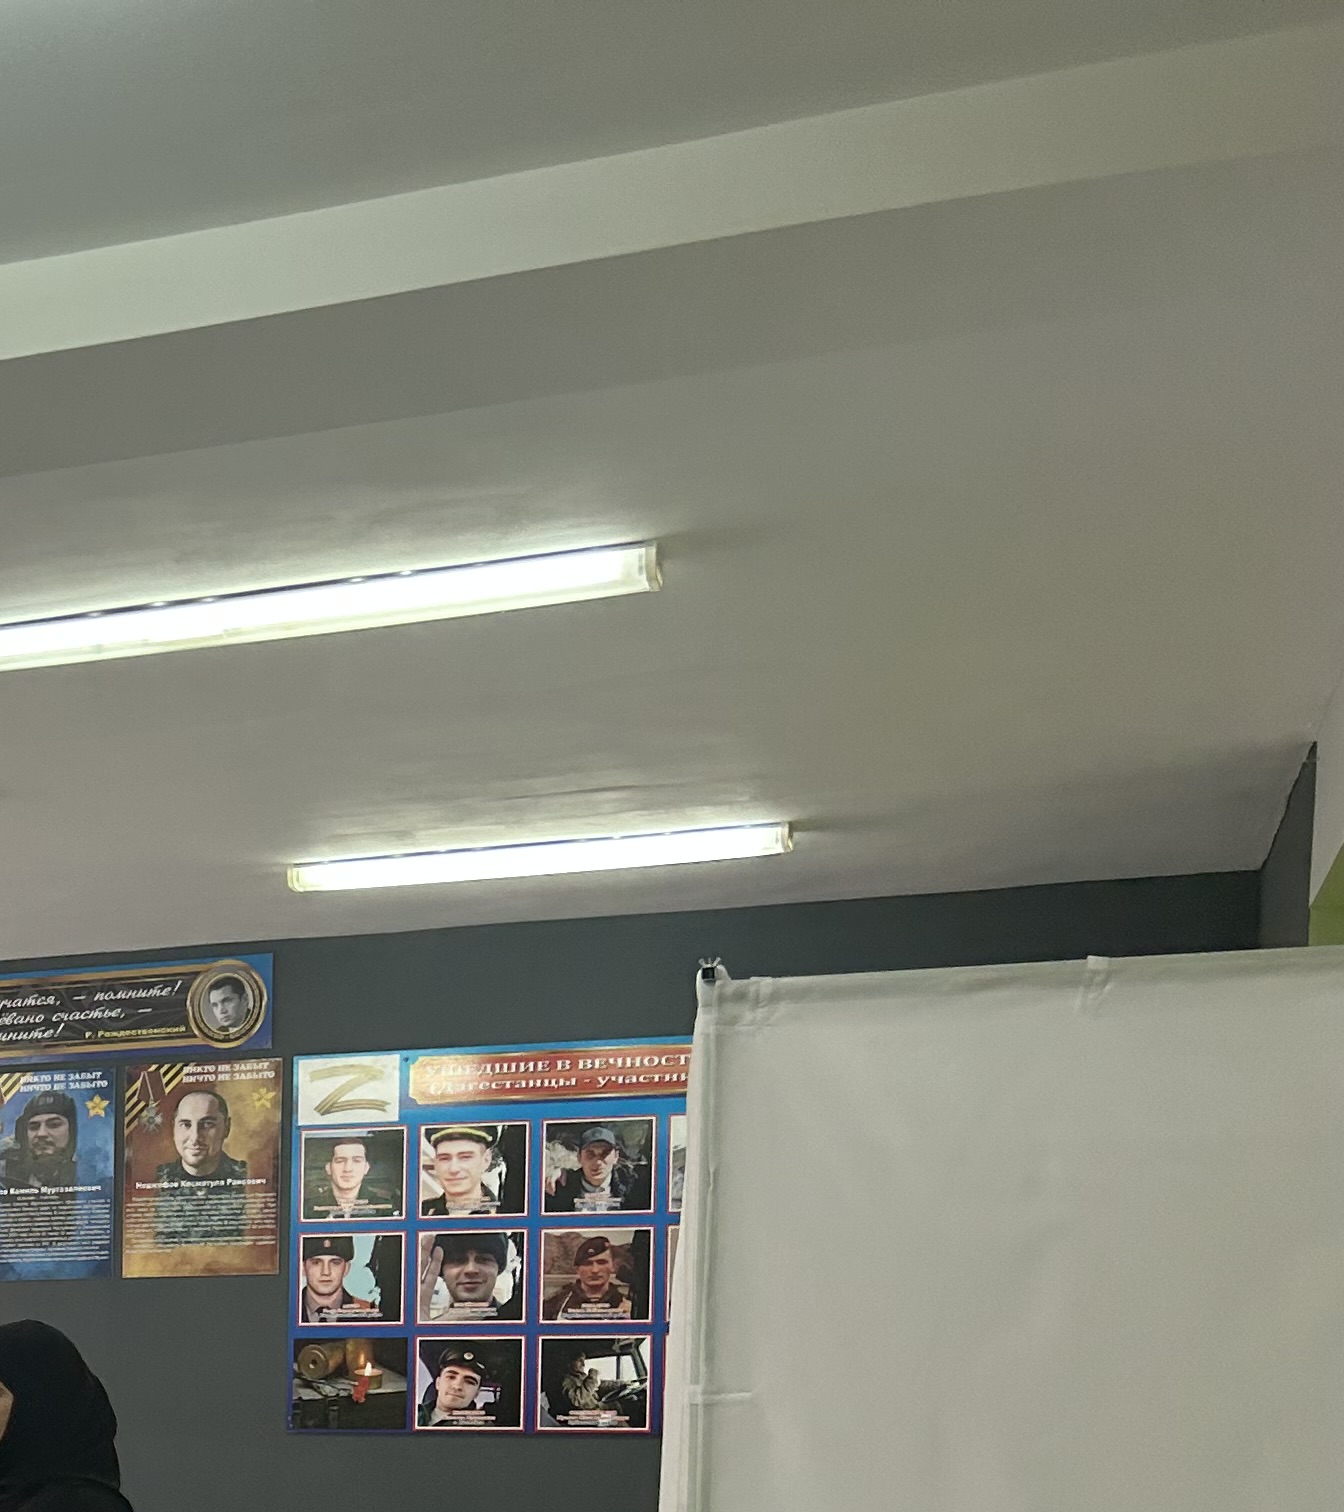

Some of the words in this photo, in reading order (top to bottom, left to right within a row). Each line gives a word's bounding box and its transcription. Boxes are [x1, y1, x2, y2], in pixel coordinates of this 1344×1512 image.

[94, 980, 183, 1001] помните!
[51, 1006, 126, 1022] счастье,
[426, 1058, 550, 1079] УШЕДШИЕ
[556, 1059, 572, 1072] В
[577, 1053, 691, 1071] ВЕЧНОСТ
[233, 1070, 275, 1080] ЗАБЫТО
[68, 1080, 109, 1090] ЗАБЫТО
